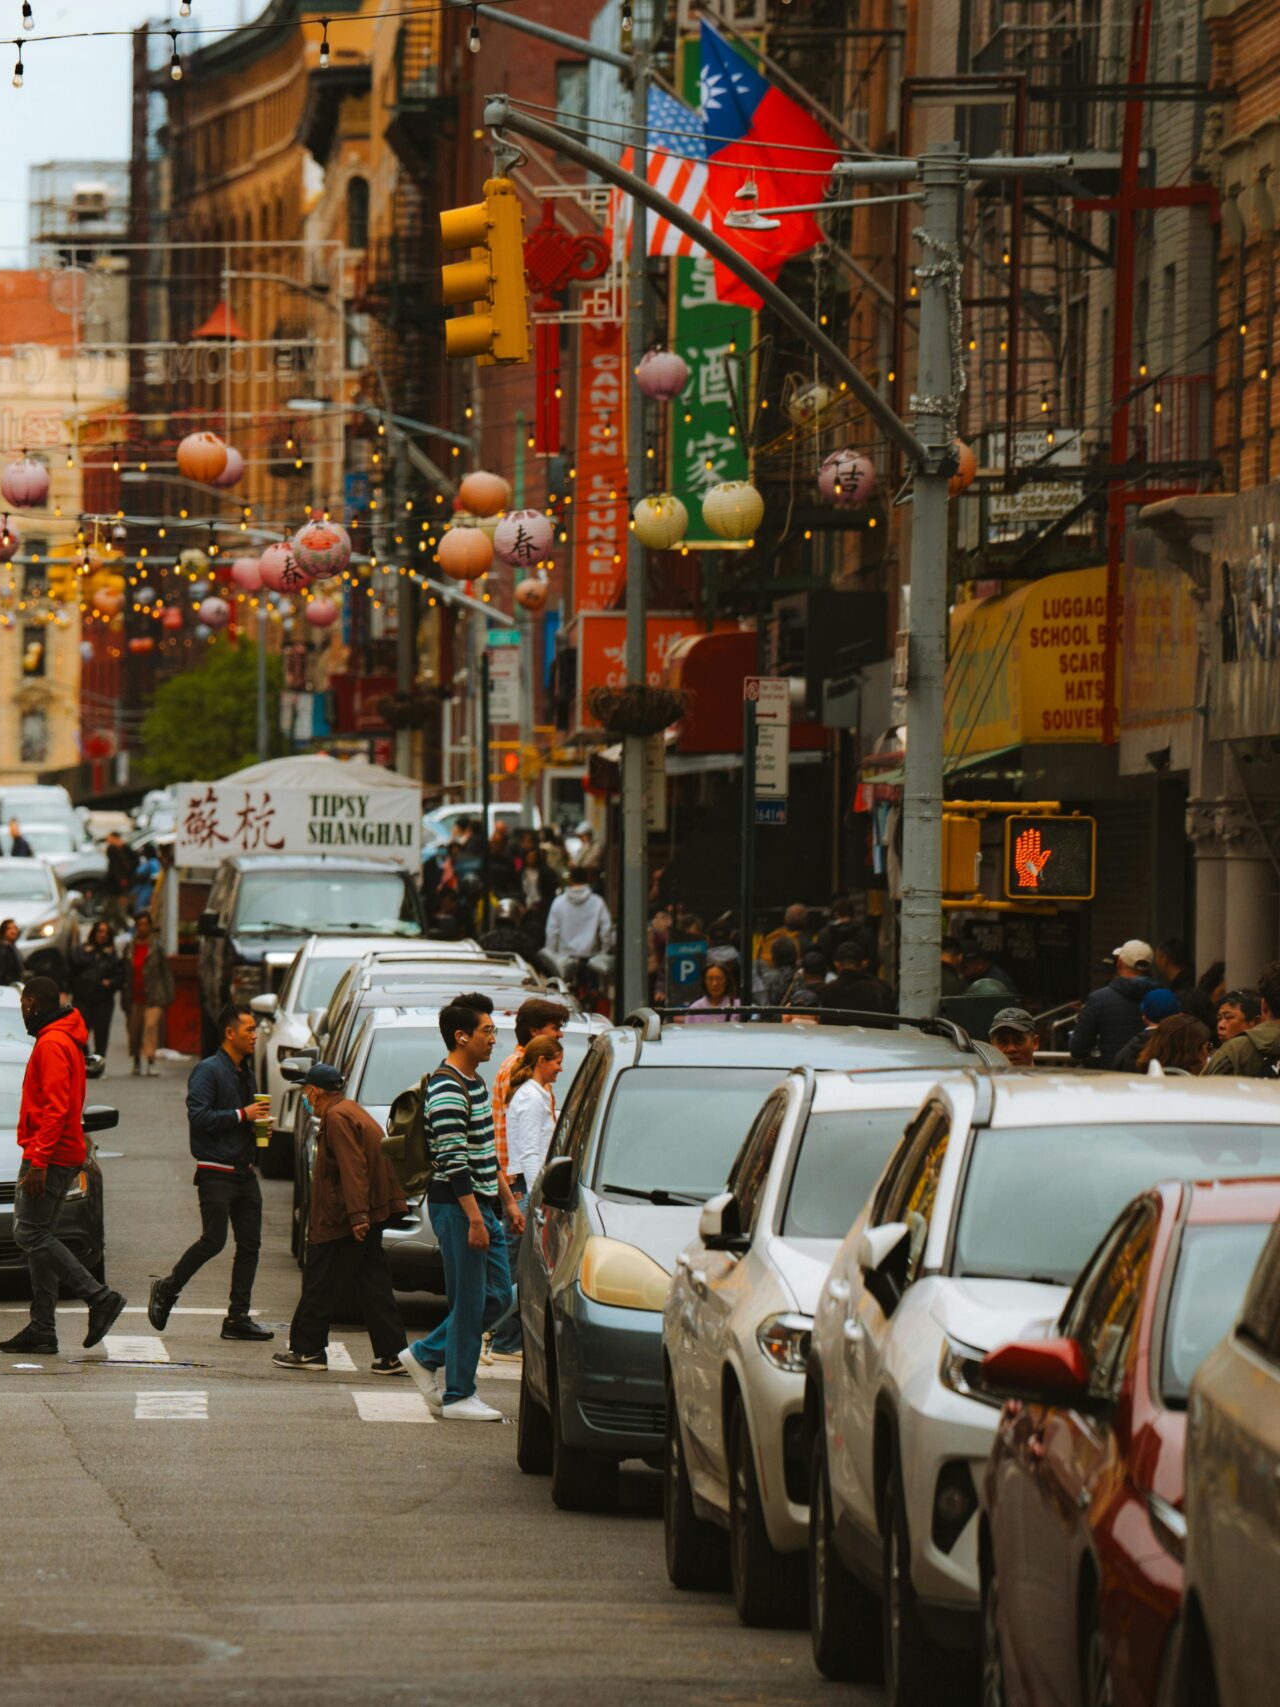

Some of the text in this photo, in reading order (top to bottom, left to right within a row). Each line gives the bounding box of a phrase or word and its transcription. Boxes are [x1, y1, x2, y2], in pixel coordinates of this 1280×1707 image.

[589, 354, 620, 455] CANTON
[587, 474, 617, 574] LOUNGE
[512, 525, 540, 559] 春
[281, 555, 304, 586] 春
[1030, 624, 1091, 648] SCHOOL
[1065, 680, 1106, 702] HATS
[181, 787, 286, 851] 蘇杭
[309, 794, 370, 818] TIPSY
[307, 821, 413, 847] SHANGHAI
[680, 960, 696, 982] P
